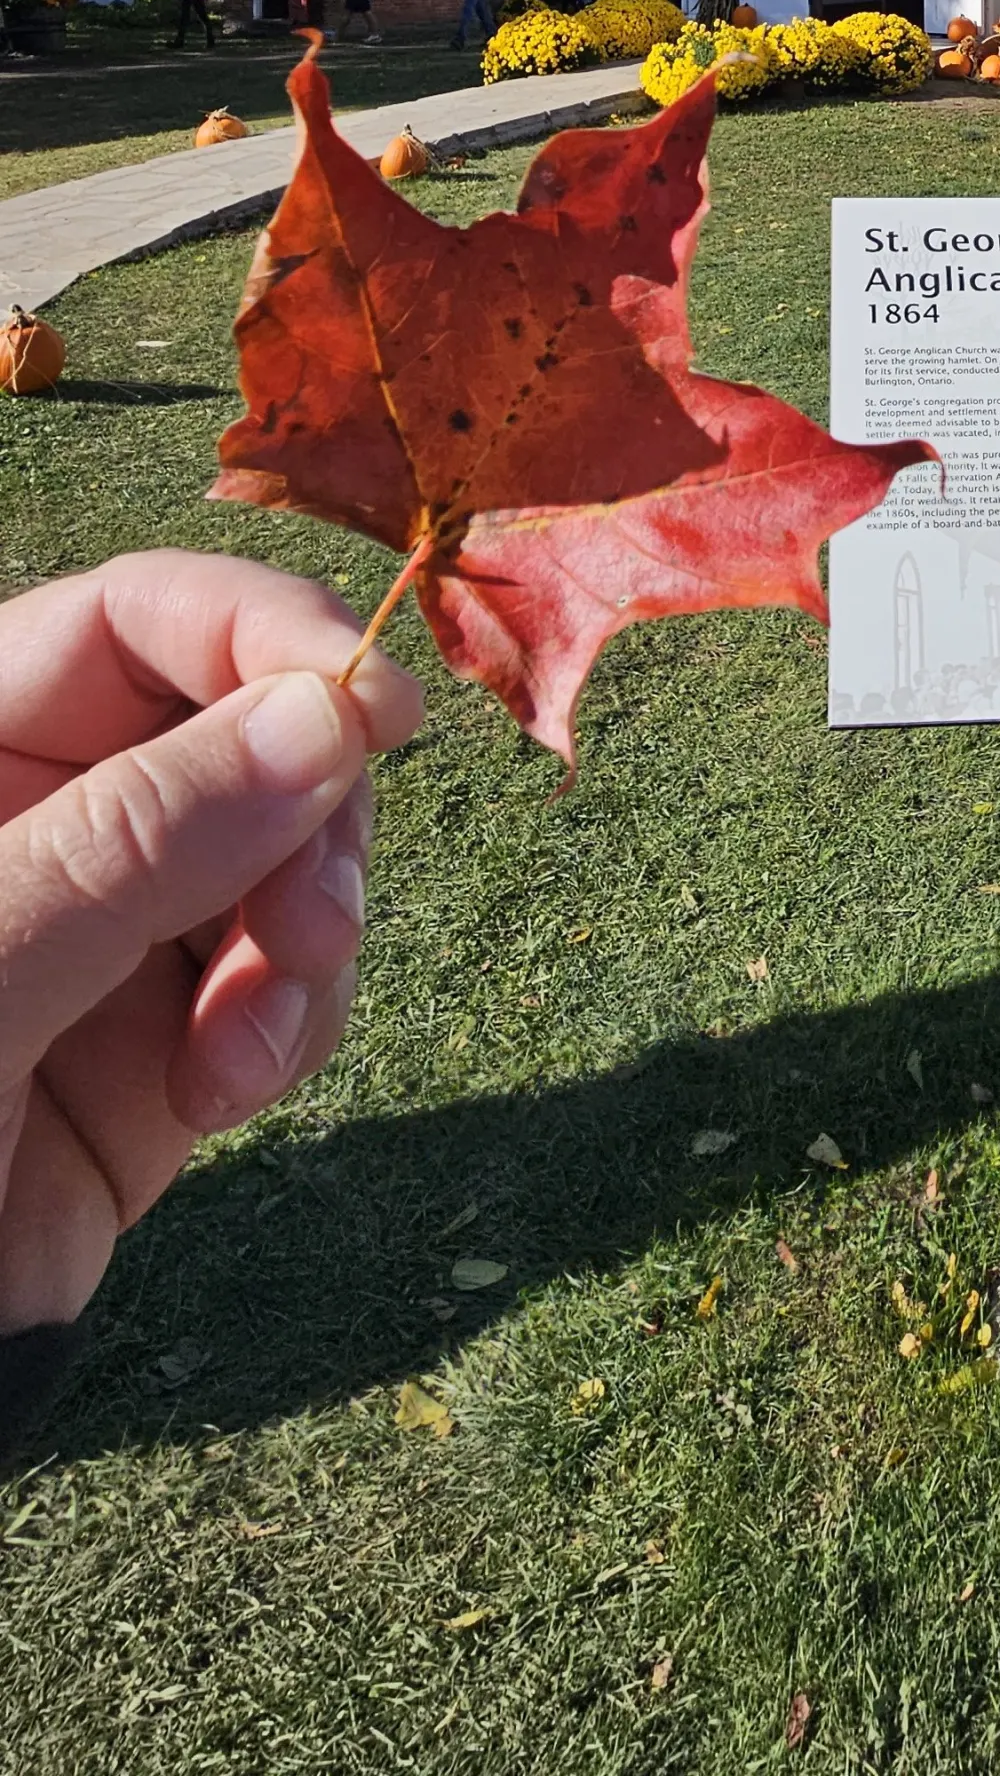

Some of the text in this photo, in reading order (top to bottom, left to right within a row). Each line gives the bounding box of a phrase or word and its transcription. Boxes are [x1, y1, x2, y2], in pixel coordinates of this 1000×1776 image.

[865, 227, 908, 252] St.
[868, 304, 940, 324] 1864
[878, 346, 910, 357] George
[914, 346, 952, 357] Anglican
[955, 345, 986, 353] Church
[891, 356, 905, 364] the
[908, 356, 944, 367] growing
[947, 355, 981, 363] hamlet.
[984, 355, 997, 363] On
[864, 367, 878, 375] for
[880, 367, 891, 375] its
[894, 366, 913, 374] first
[915, 366, 949, 376] service,
[952, 365, 999, 374] conducted
[864, 377, 955, 388] Burlington, Ontario.
[879, 397, 920, 408] George's
[923, 397, 983, 408] congregation
[864, 408, 925, 419] development
[927, 407, 944, 415] and
[947, 407, 996, 415] settlement
[894, 418, 932, 427] deemed
[935, 418, 978, 426] advisable
[980, 417, 991, 425] to
[865, 430, 895, 438] settler
[897, 429, 929, 438] church
[952, 428, 991, 438] vacated,
[905, 474, 927, 482] Falls
[902, 485, 935, 495] Today,
[956, 484, 989, 492] church
[992, 483, 1000, 491] is
[901, 496, 913, 504] for
[922, 506, 966, 518] including
[969, 506, 984, 515] the
[866, 520, 908, 531] example
[910, 520, 922, 528] of
